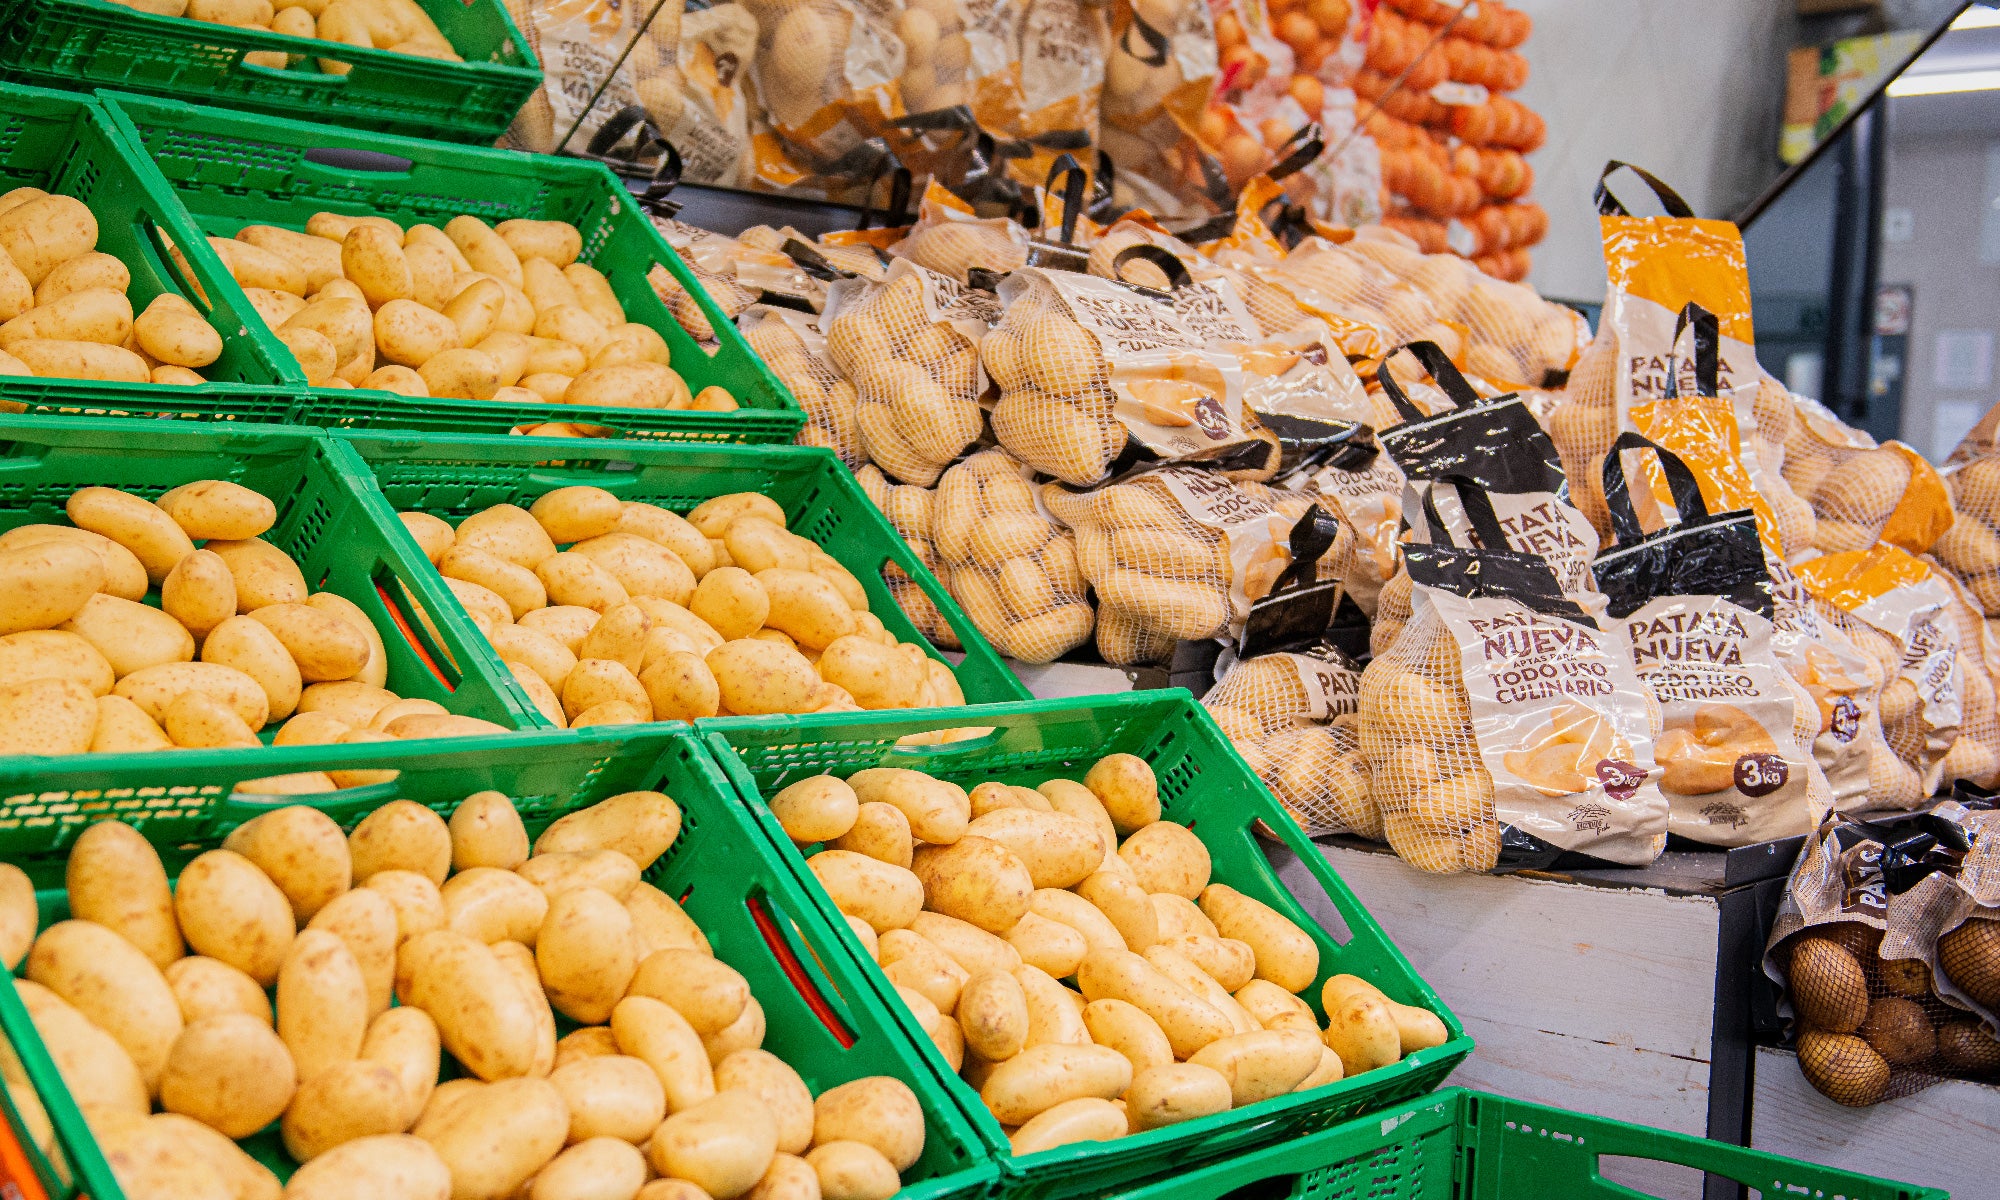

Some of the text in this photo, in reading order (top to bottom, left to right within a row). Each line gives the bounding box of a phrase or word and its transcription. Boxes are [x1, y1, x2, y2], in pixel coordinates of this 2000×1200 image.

[1631, 374, 1734, 396] NUEA
[1549, 551, 1572, 561] PARA
[1628, 610, 1749, 644] PATATA
[1480, 622, 1600, 661] NUEVA
[1632, 636, 1744, 667] NUEVA
[1488, 662, 1608, 688] TODO USO
[1513, 655, 1548, 669] APTAS
[1496, 679, 1615, 705] CULINARIO
[1637, 672, 1754, 689] TODO USO
[1655, 687, 1761, 704] ULINARIO
[1741, 759, 1781, 787] 3kg
